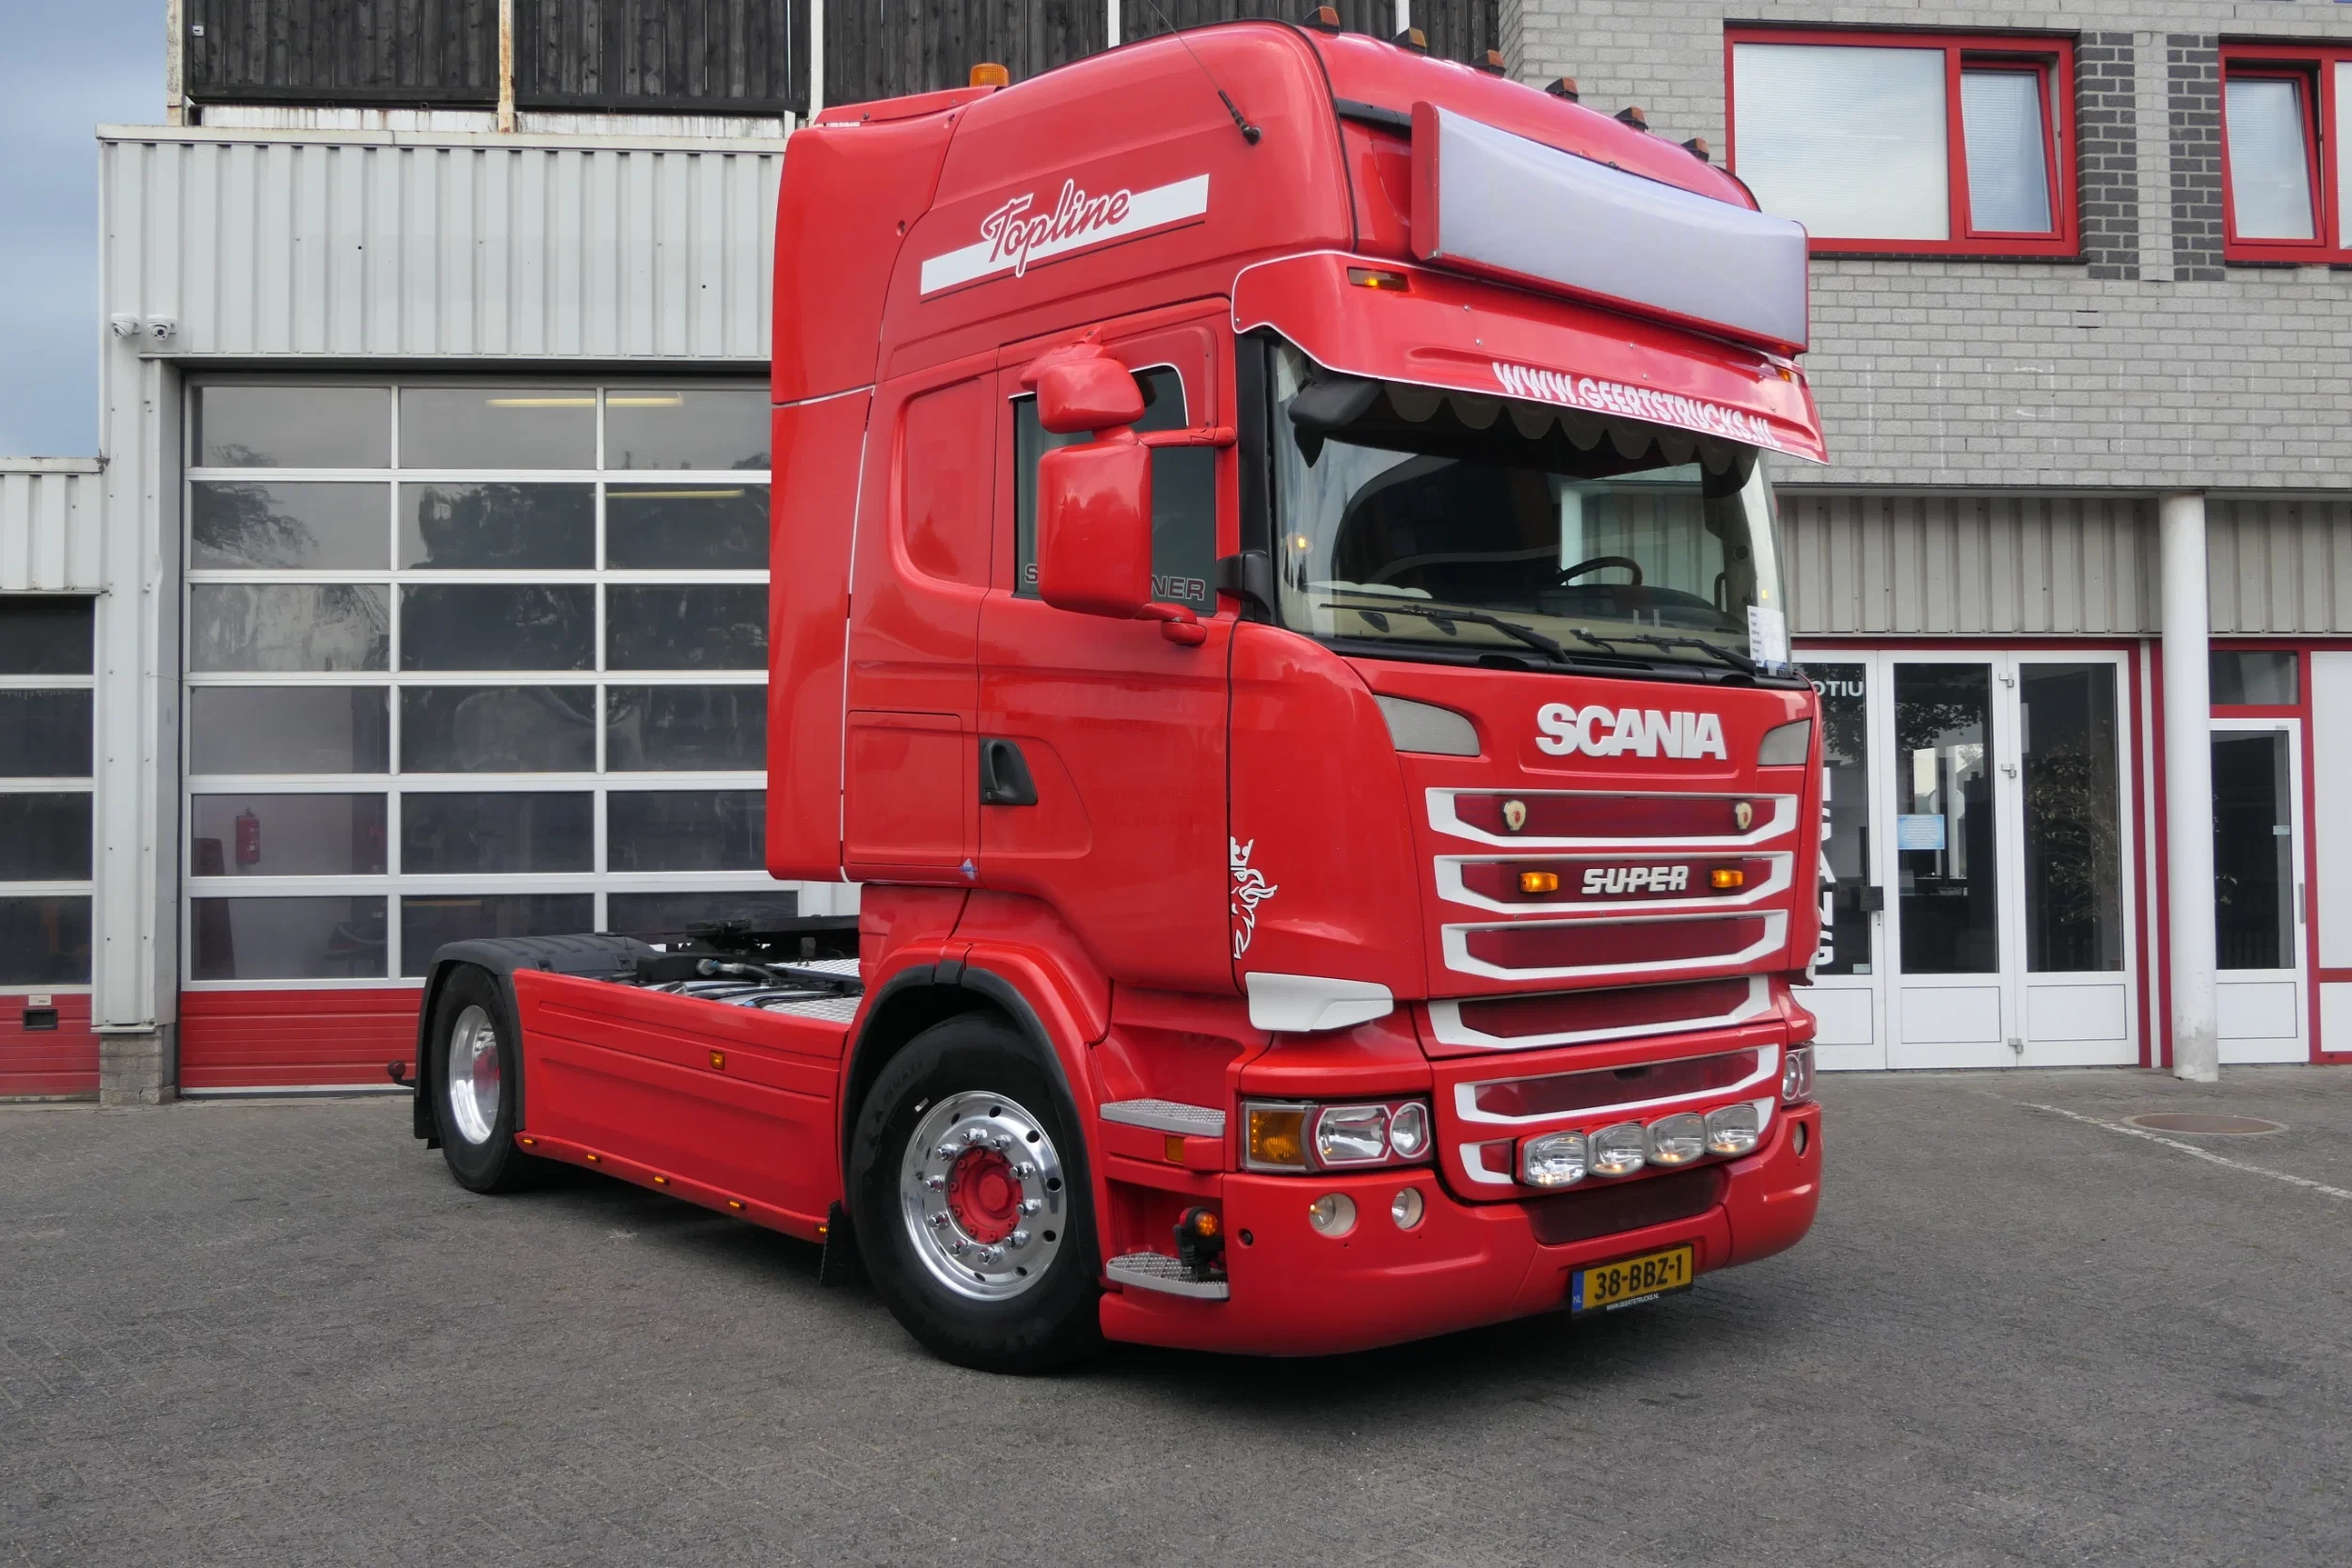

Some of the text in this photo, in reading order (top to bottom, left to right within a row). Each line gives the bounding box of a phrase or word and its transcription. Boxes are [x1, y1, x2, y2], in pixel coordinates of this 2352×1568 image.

[980, 179, 1131, 277] Topline
[1492, 362, 1780, 447] WWW.GEERTSTRUCKS.NL
[1535, 703, 1727, 760] SCANIA
[1581, 865, 1689, 895] SUPER
[1573, 1295, 1581, 1304] NL
[1595, 1254, 1682, 1300] 38-BBZ-1
